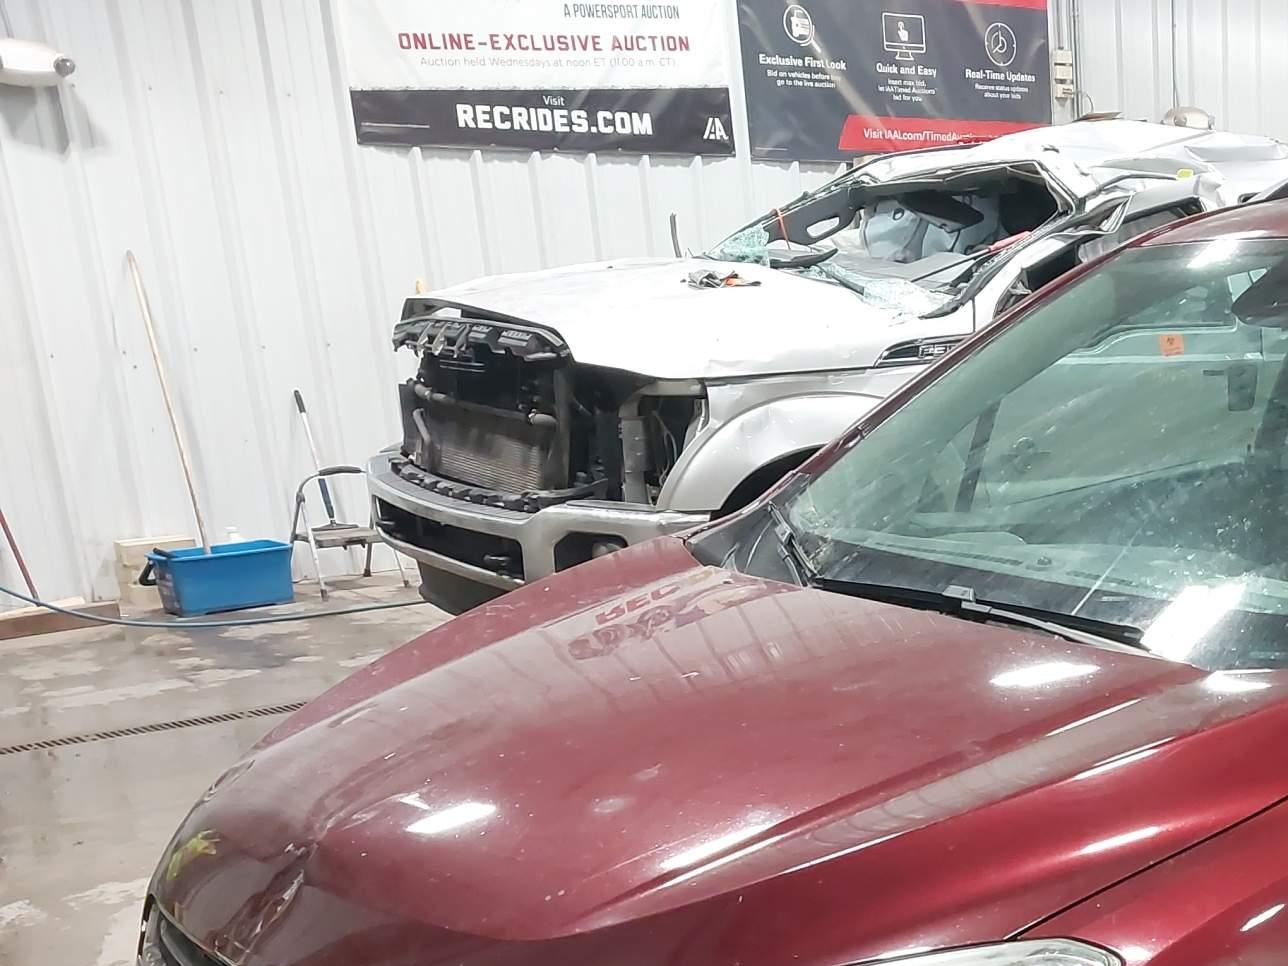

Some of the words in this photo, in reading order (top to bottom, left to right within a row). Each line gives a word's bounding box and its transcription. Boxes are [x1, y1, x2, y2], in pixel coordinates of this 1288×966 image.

[564, 4, 571, 18] A
[573, 4, 639, 19] POWERSPORT
[641, 5, 680, 19] AUCTION
[398, 33, 602, 52] ONLINE-EXCLUSIVE
[611, 34, 690, 52] AUCTION
[420, 57, 460, 66] Auction
[463, 57, 485, 66] held
[490, 57, 551, 68] Wednesdays
[553, 58, 563, 67] at
[566, 59, 590, 67] noon
[594, 58, 606, 67] ET
[759, 53, 803, 67] Exclusive
[804, 57, 825, 68] First
[825, 59, 847, 71] Look
[876, 62, 898, 74] Quick
[900, 65, 916, 75] and
[917, 65, 937, 78] Easy
[965, 68, 1005, 81] Real-Time
[1006, 71, 1036, 83] Updates
[543, 95, 565, 107] Visit
[456, 104, 653, 135] RECRIDES.COM
[863, 128, 883, 139] Visit
